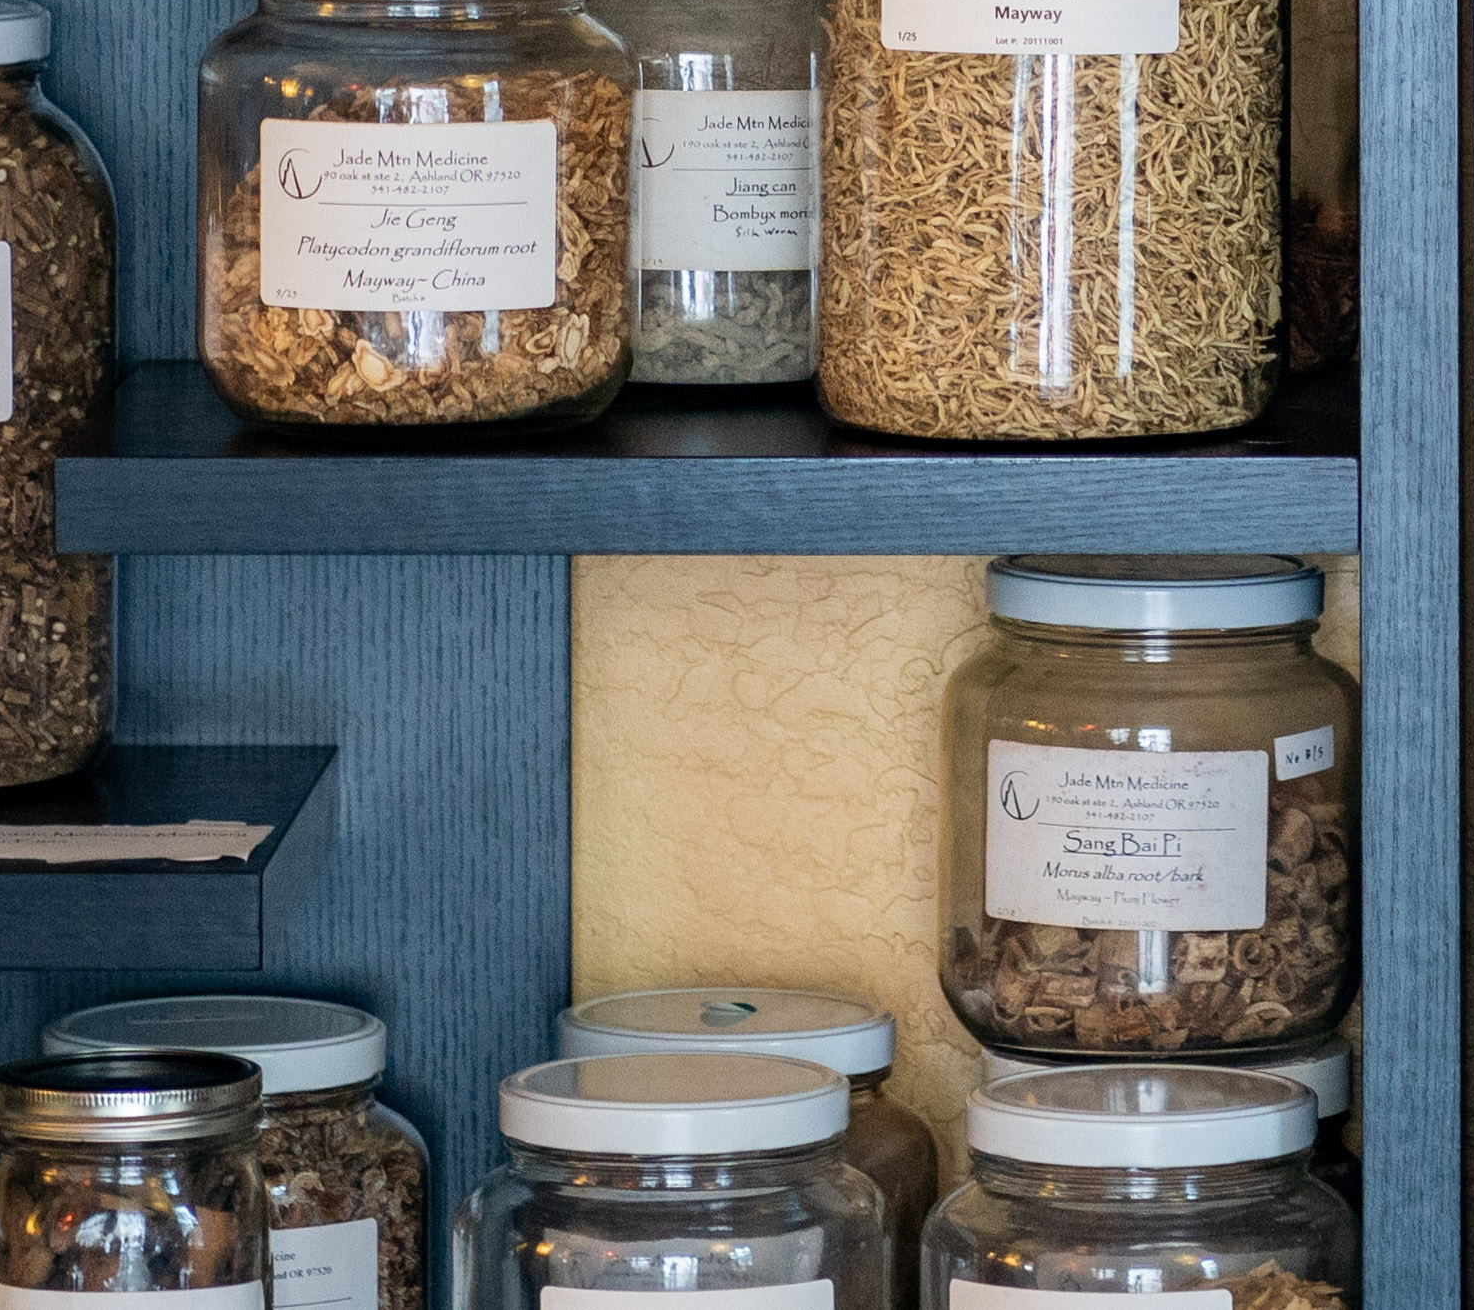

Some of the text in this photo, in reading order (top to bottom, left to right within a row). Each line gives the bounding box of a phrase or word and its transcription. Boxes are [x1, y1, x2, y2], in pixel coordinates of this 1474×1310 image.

[995, 6, 1062, 23] Mayway
[898, 32, 917, 41] 1/25
[727, 179, 796, 197] Jiang can
[371, 208, 457, 231] Jie Geng
[1063, 830, 1181, 855] Sang Bai Pi
